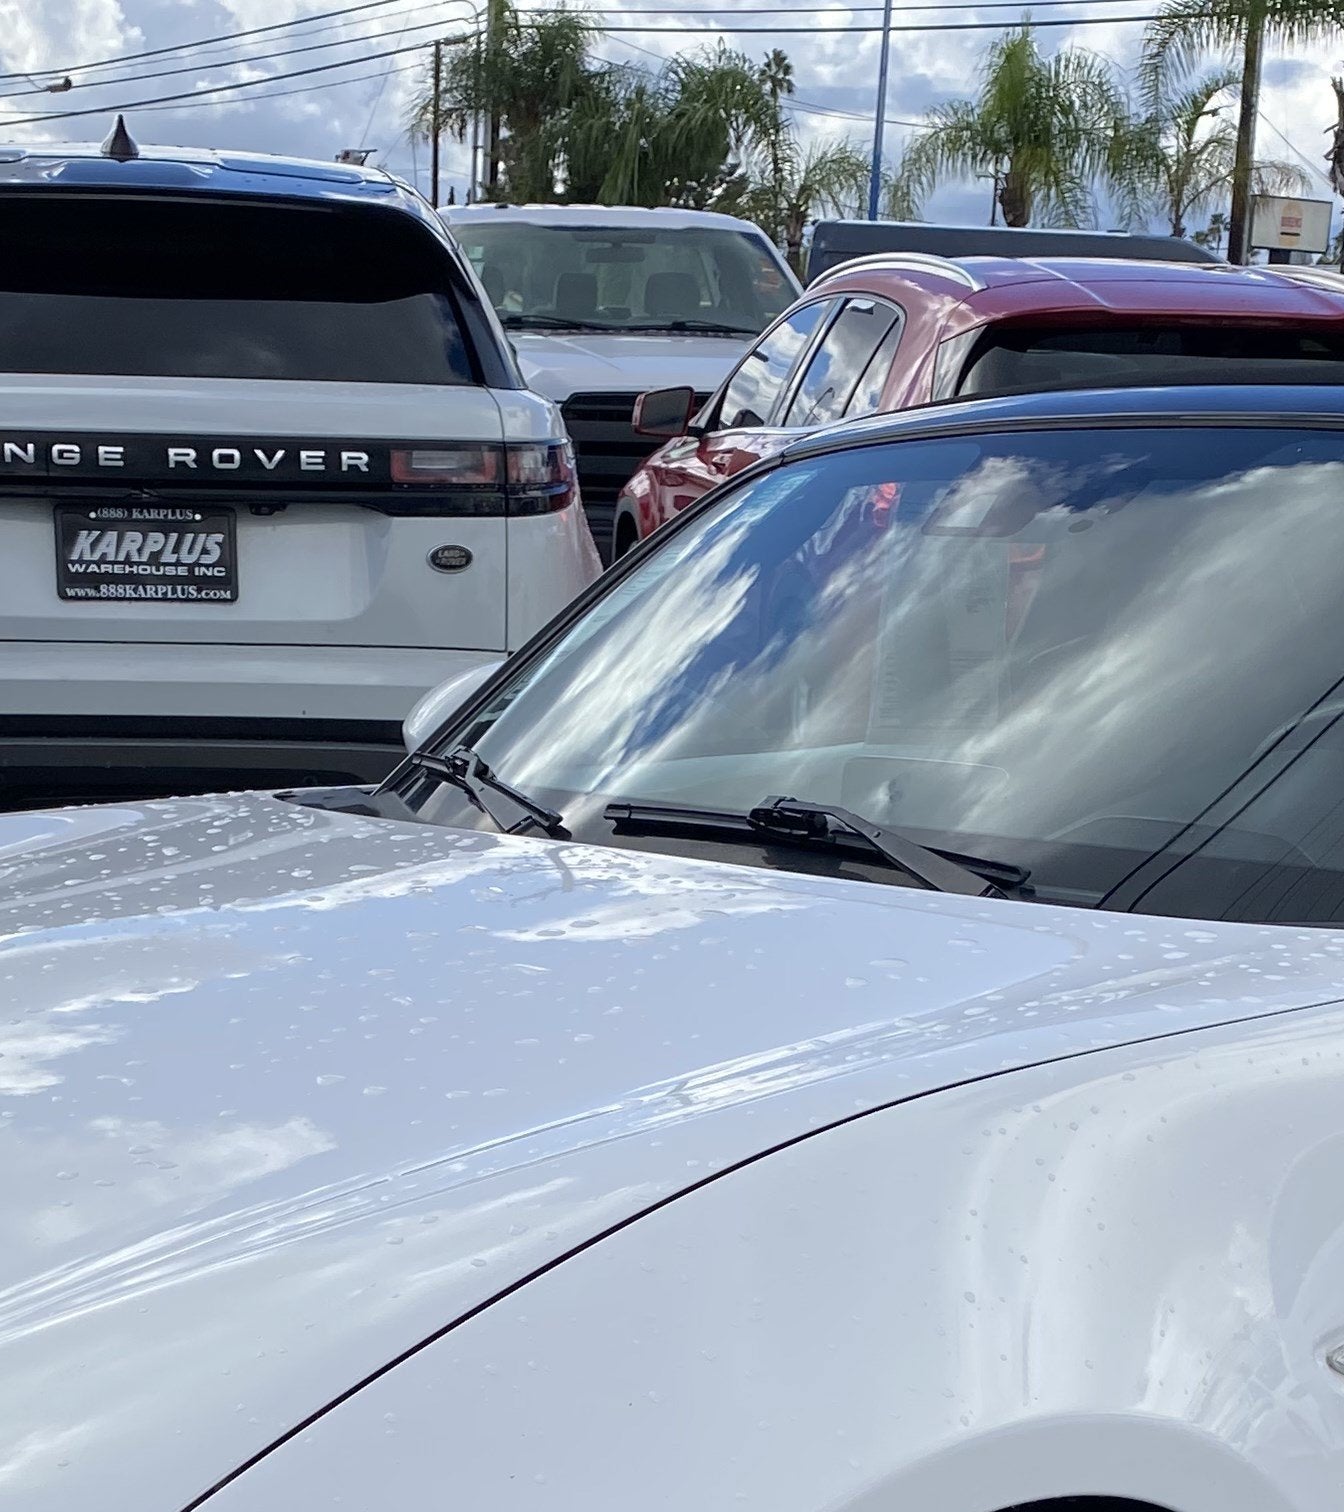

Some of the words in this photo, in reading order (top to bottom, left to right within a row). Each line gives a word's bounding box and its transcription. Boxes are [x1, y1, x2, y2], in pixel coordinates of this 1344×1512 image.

[167, 447, 370, 472] ROVER
[97, 508, 128, 519] (888)
[132, 508, 194, 520] KARPLUS
[69, 530, 225, 564] KARPLUS
[67, 563, 189, 575] WAREHOUSE
[194, 566, 227, 577] INC
